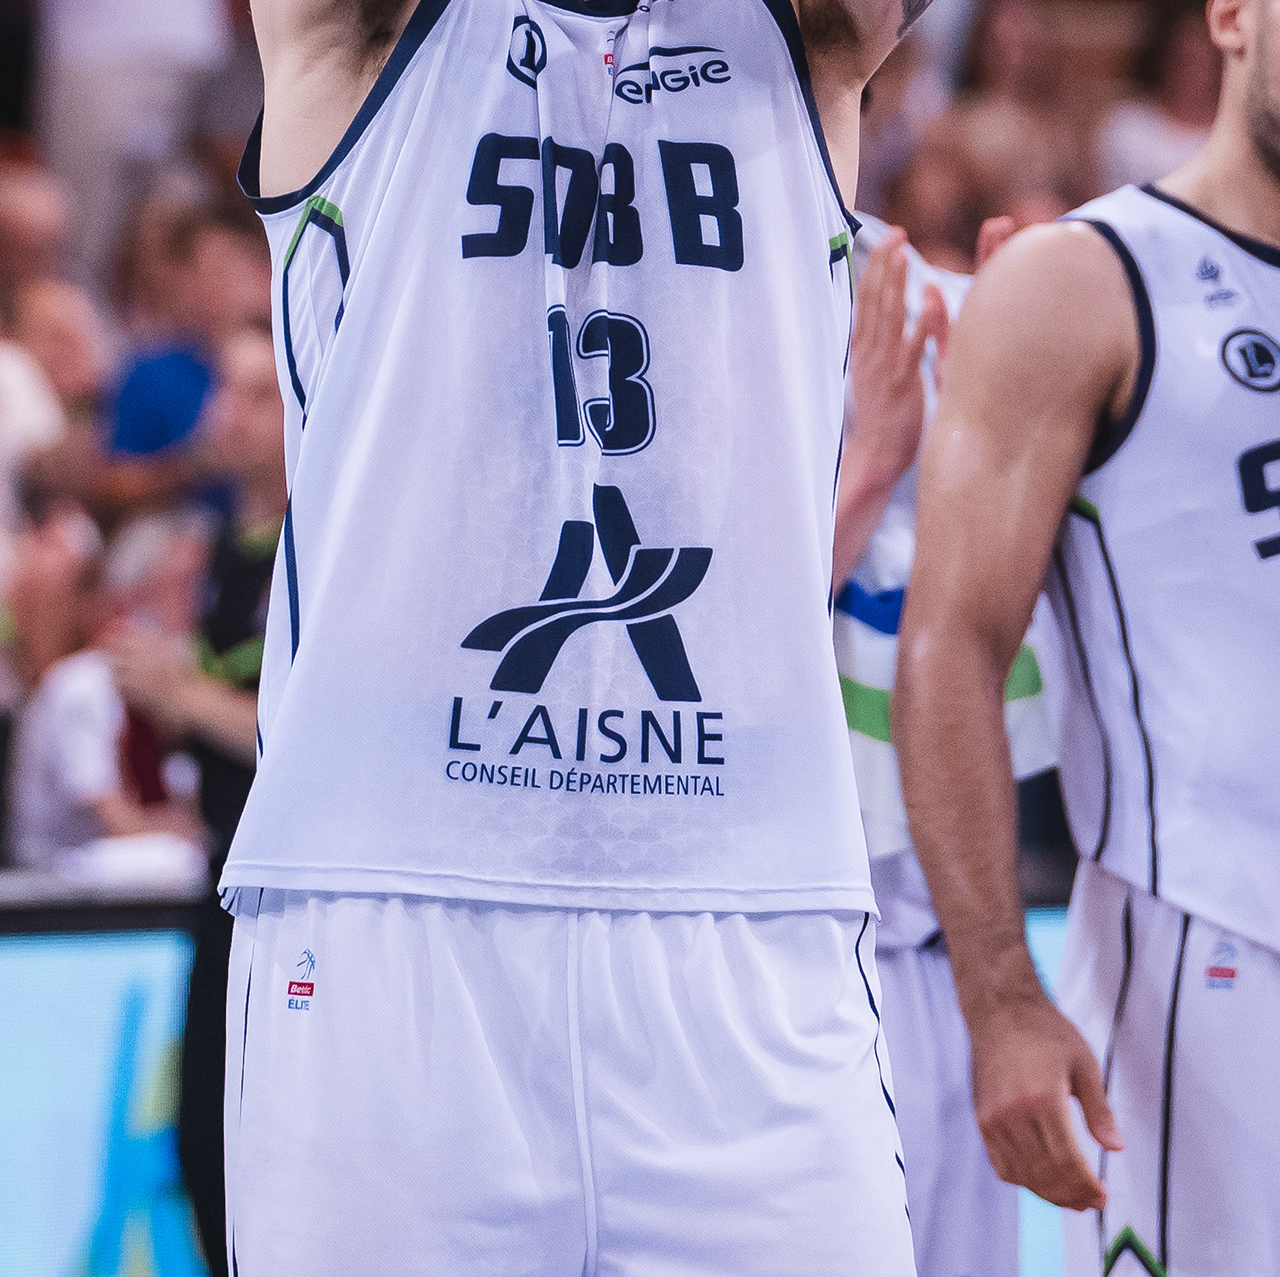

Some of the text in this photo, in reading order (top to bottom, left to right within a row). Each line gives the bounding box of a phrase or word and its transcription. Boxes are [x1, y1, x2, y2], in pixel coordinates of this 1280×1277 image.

[547, 304, 657, 457] 13
[448, 696, 725, 765] L'AISNE
[445, 760, 725, 797] CONSEIL DÉPARTEMENTAL
